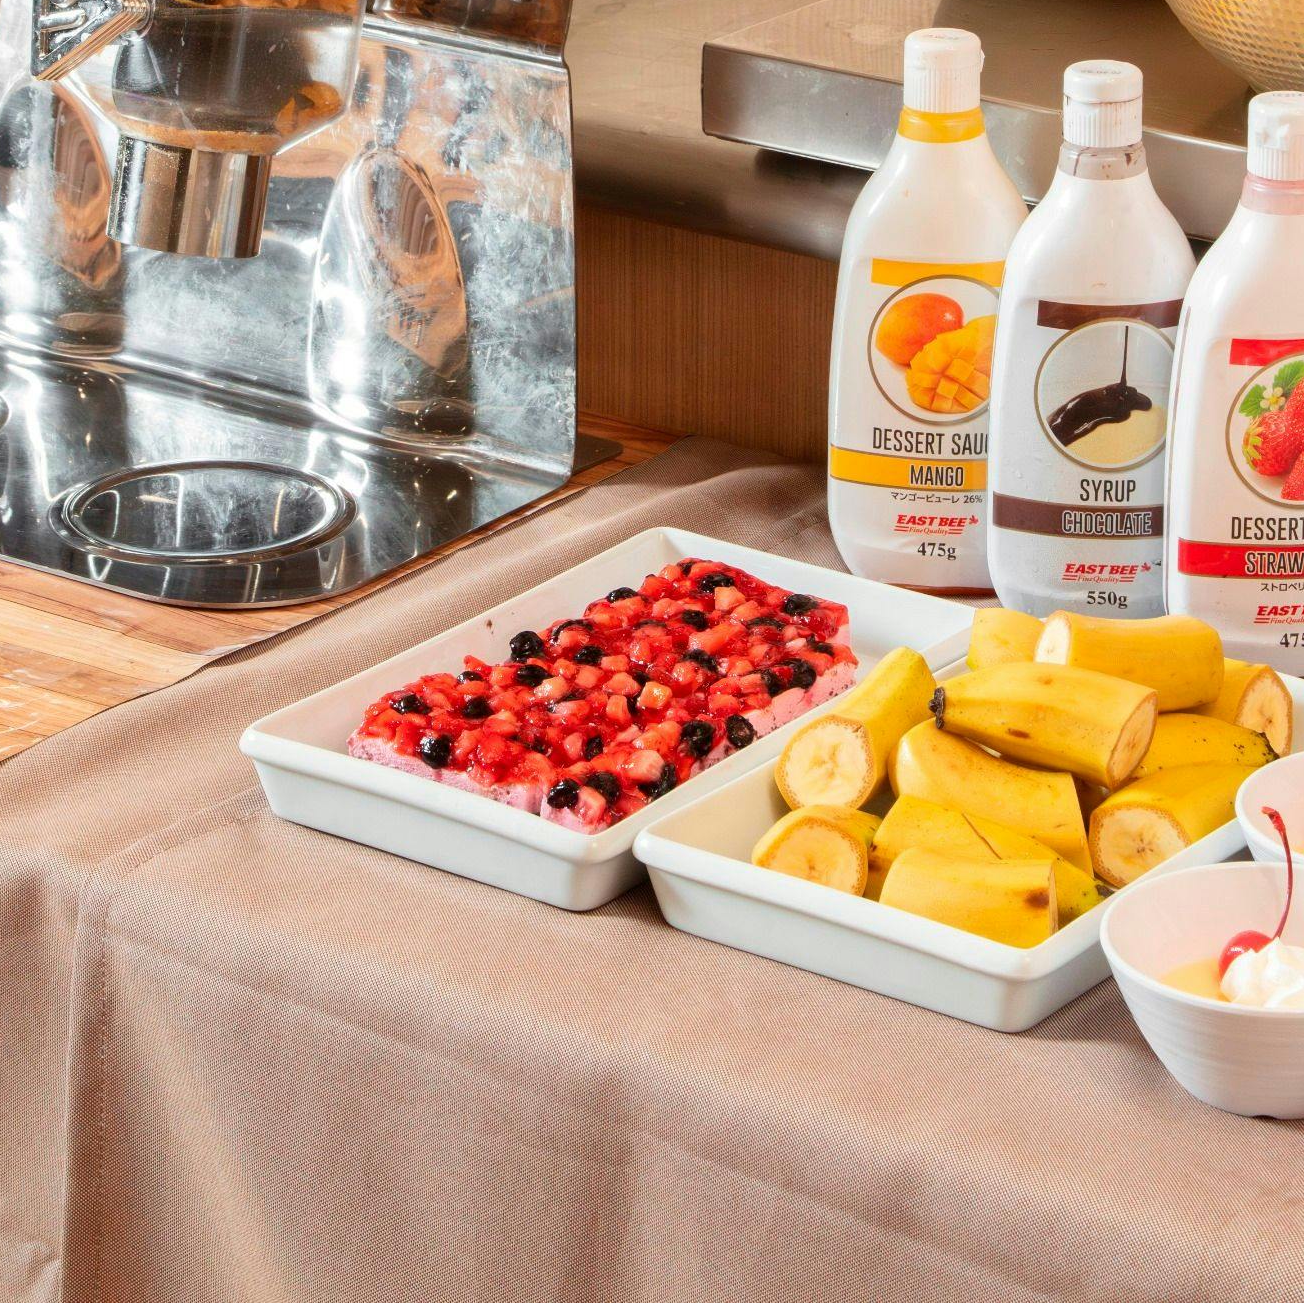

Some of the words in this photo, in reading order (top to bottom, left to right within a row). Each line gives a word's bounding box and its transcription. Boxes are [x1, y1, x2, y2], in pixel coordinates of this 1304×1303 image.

[872, 427, 946, 455] DESSERT
[951, 432, 988, 456] SAU
[910, 464, 964, 487] MANGO
[963, 494, 983, 504] 26%
[1079, 478, 1137, 503] SYRUP
[896, 514, 938, 527] EAST
[938, 516, 968, 528] BEE
[1062, 510, 1152, 535] CHOCOLATE
[917, 542, 957, 561] 475g
[1064, 563, 1108, 575] EAST
[1108, 564, 1139, 575] BEE
[1086, 590, 1128, 609] 550g
[1256, 604, 1301, 616] EAST
